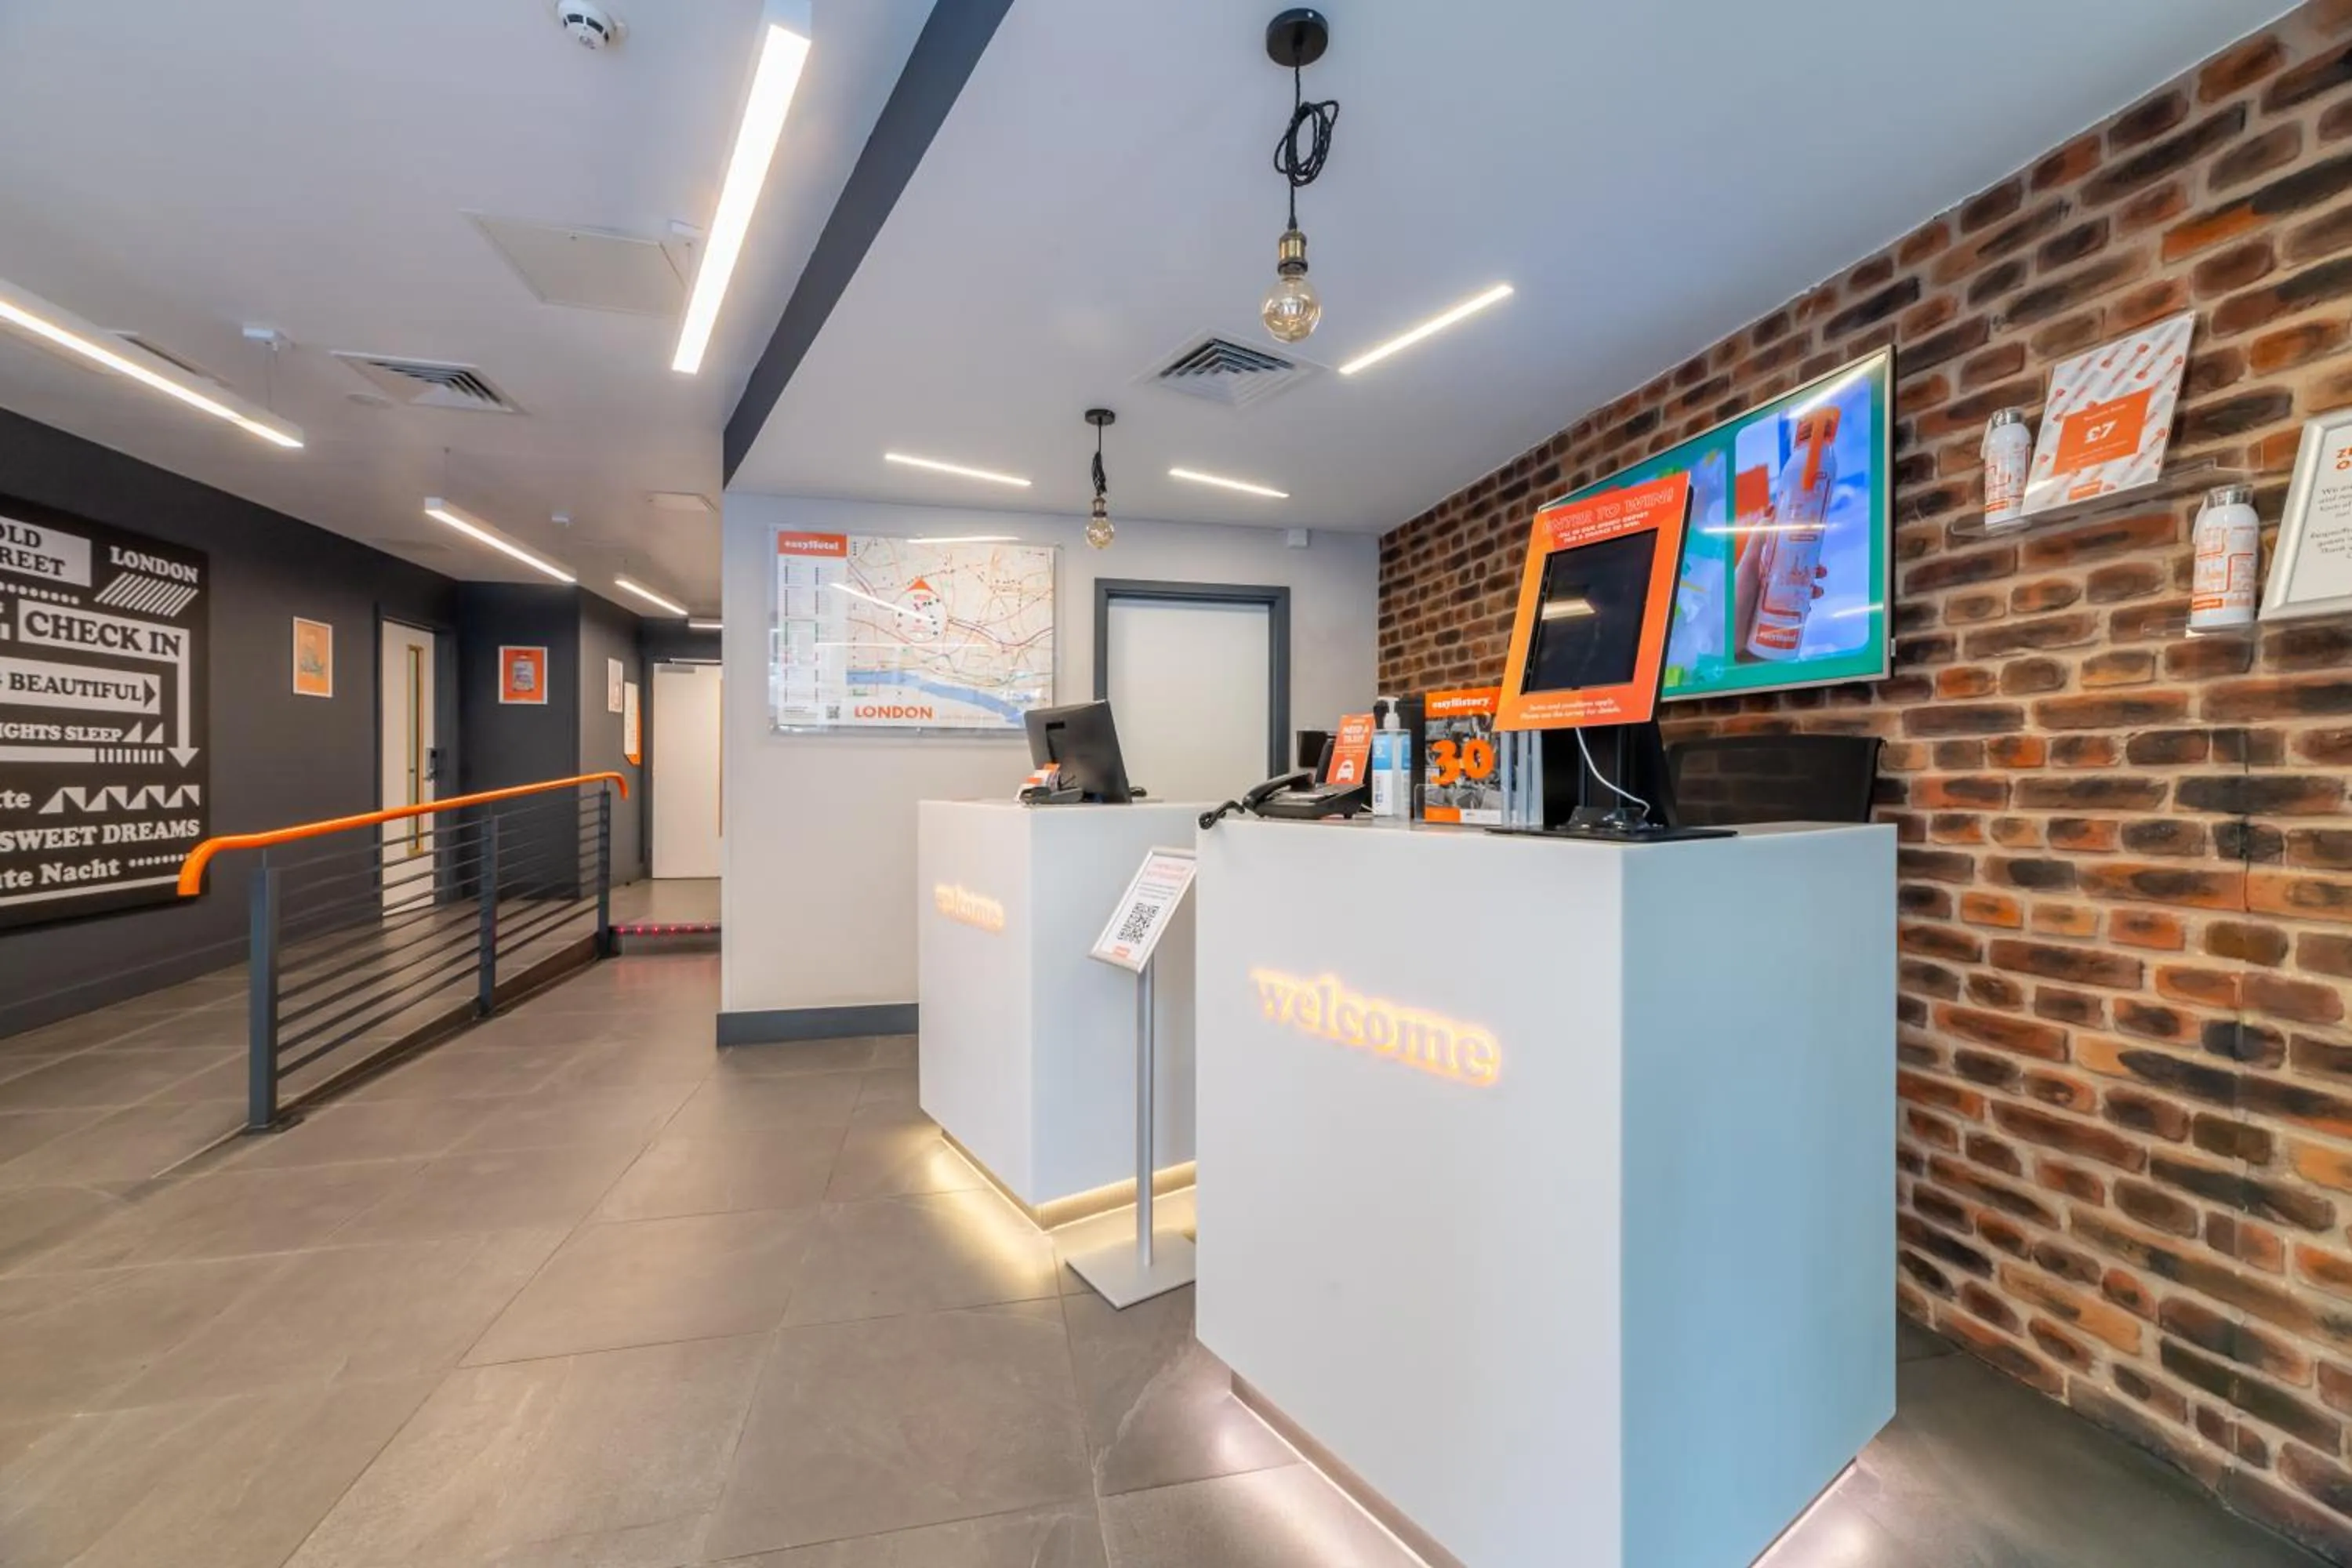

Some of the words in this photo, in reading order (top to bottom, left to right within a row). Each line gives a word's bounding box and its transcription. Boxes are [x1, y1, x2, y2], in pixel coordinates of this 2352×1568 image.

[2085, 419, 2118, 444] £7
[109, 546, 199, 583] LONDON
[25, 610, 143, 652] CHECK
[149, 631, 181, 657] IN
[9, 672, 142, 701] BEAUTIFUL
[855, 705, 932, 719] LONDON
[64, 725, 123, 742] SLEEP
[1429, 739, 1494, 786] 30
[0, 789, 32, 808] te
[0, 826, 97, 852] SWEET
[103, 819, 201, 844] DREAMS
[40, 858, 120, 884] Nacht
[1252, 971, 1498, 1086] welcome
